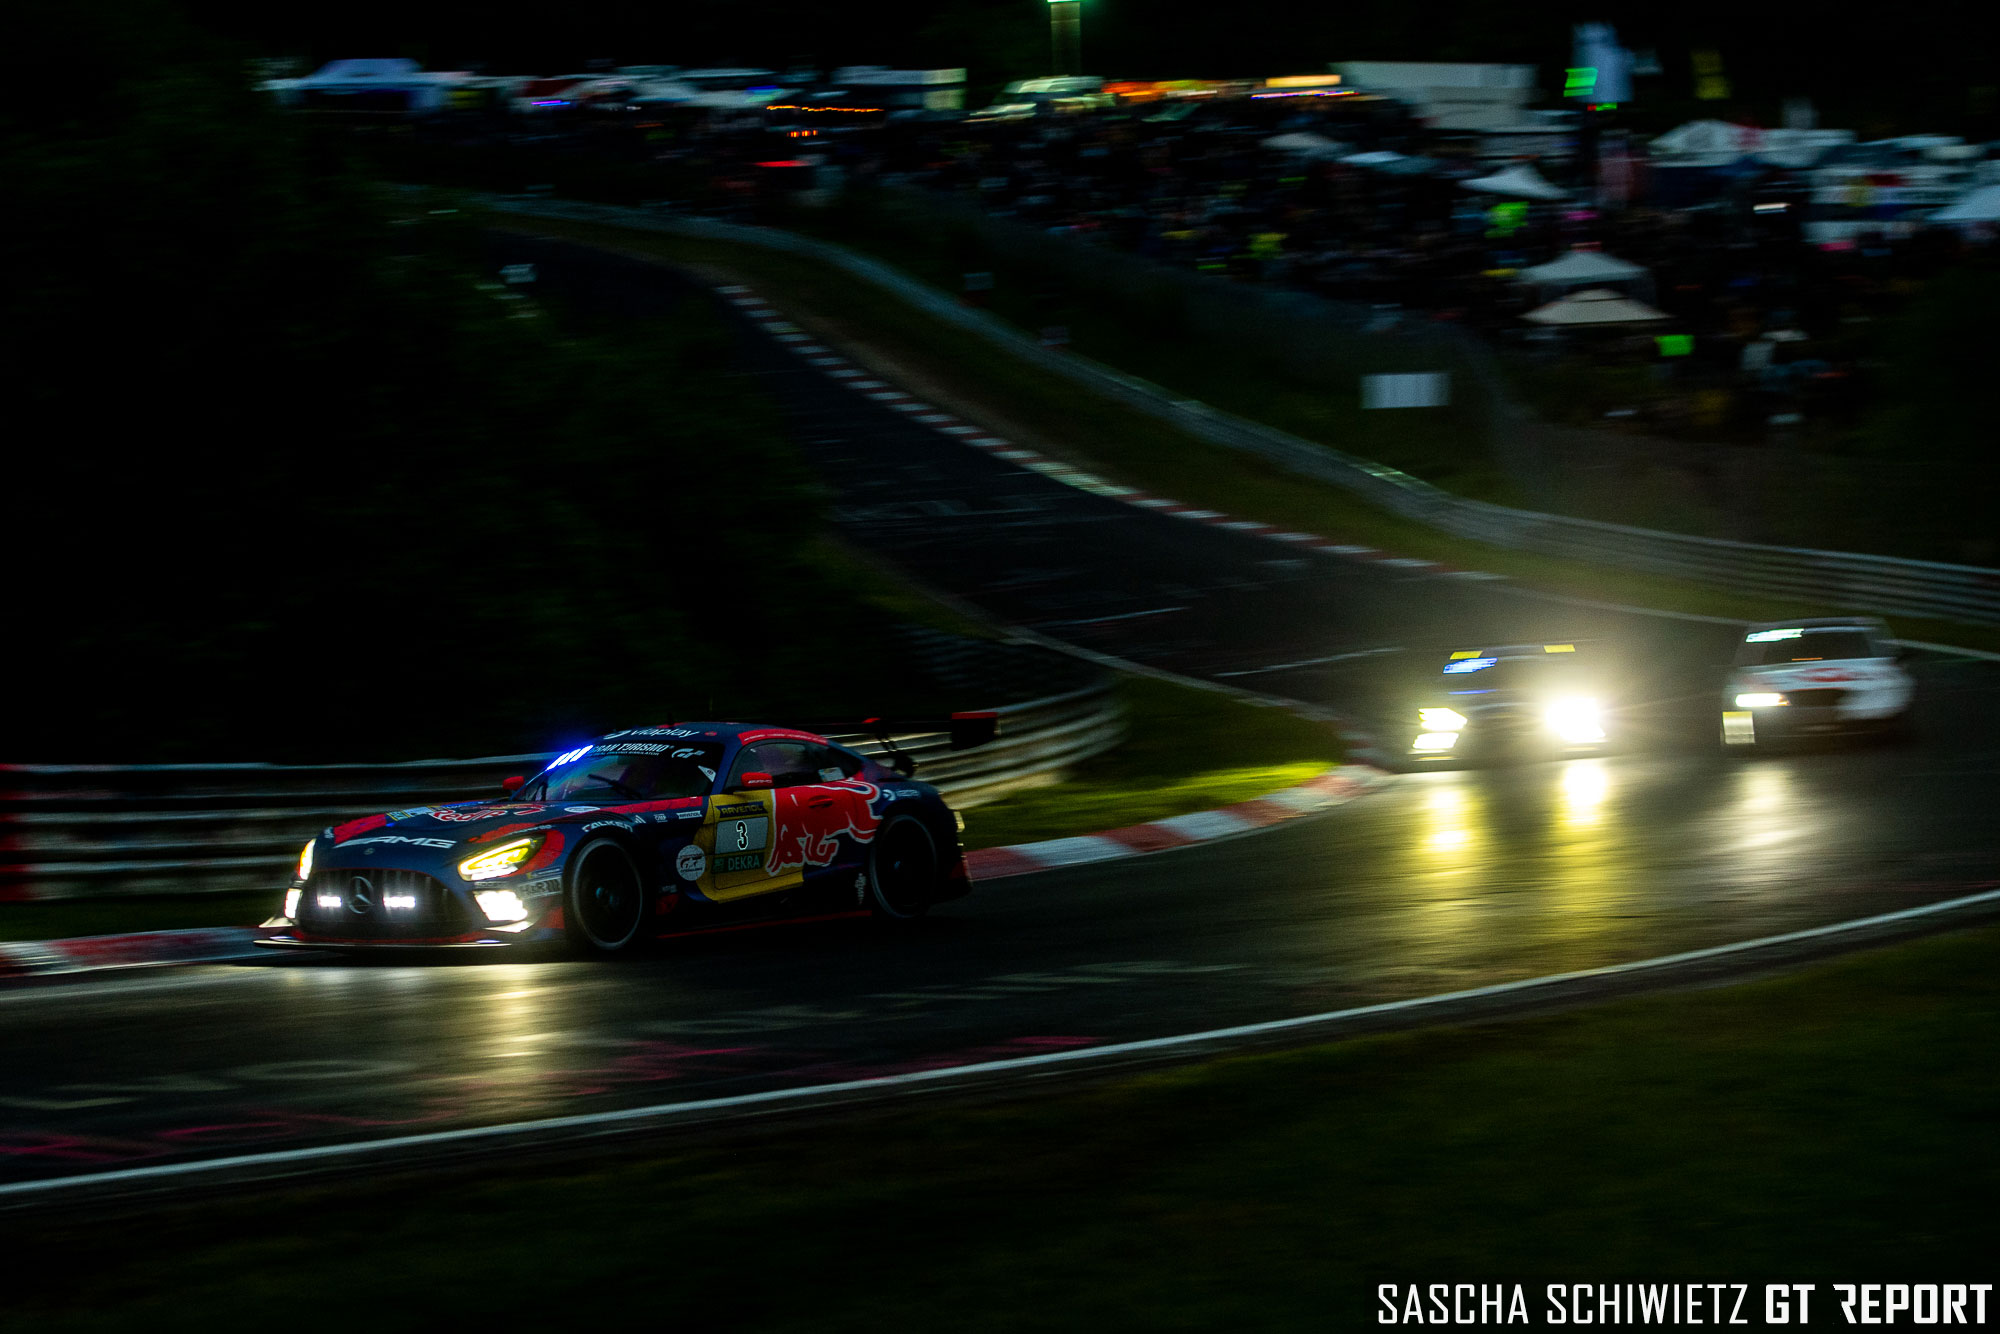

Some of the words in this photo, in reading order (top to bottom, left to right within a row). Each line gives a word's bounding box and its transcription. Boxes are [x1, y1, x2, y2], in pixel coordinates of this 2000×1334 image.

[630, 728, 700, 738] viaplay
[617, 742, 669, 752] TURISMO
[720, 804, 764, 815] RAVENOL
[736, 820, 749, 851] 3
[362, 836, 457, 849] AMG
[728, 854, 761, 871] DEKRA
